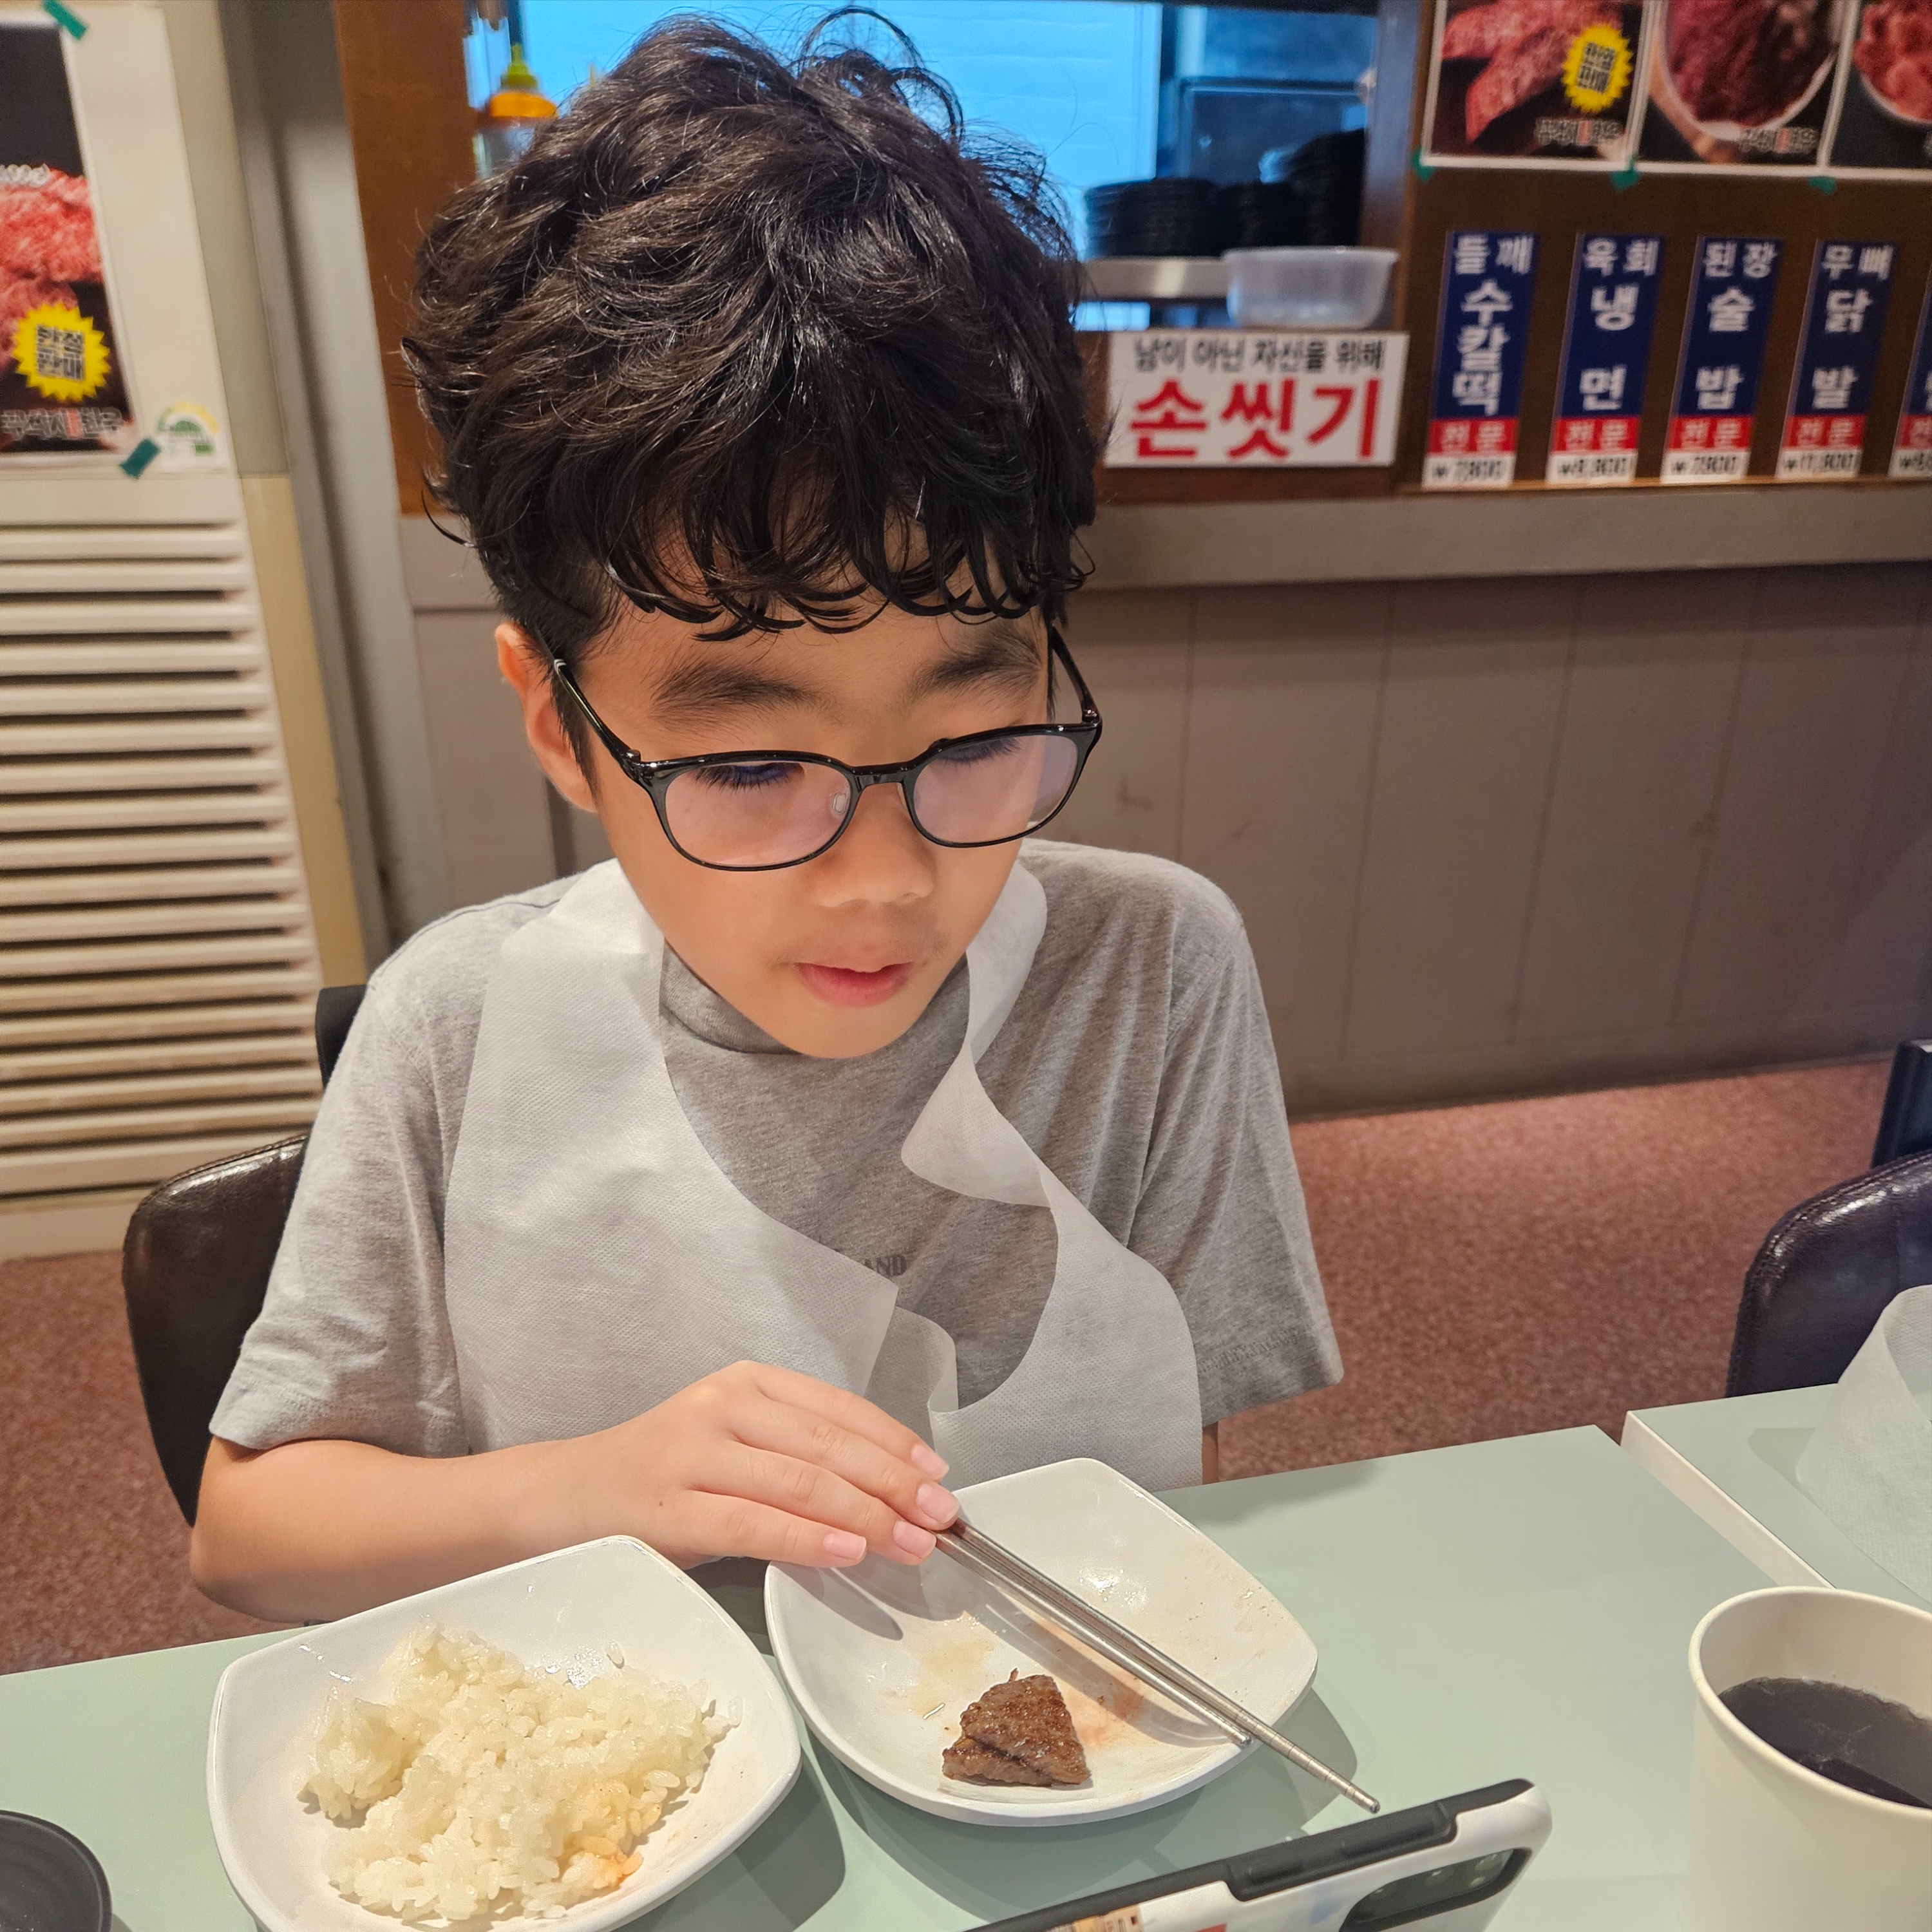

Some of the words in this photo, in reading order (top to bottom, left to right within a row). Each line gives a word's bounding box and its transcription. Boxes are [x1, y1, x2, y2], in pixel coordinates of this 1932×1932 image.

[1584, 238, 1659, 276] 육회
[1704, 242, 1776, 278] 된장
[1134, 339, 1186, 372] 남이
[1193, 339, 1245, 372] 아닌
[1253, 338, 1327, 374] 자신을
[1336, 339, 1385, 372] 위해
[1580, 284, 1638, 412] 냉면
[1696, 287, 1755, 410] 술밥
[1812, 288, 1873, 409] 닭발
[1129, 377, 1381, 460] 손씻기
